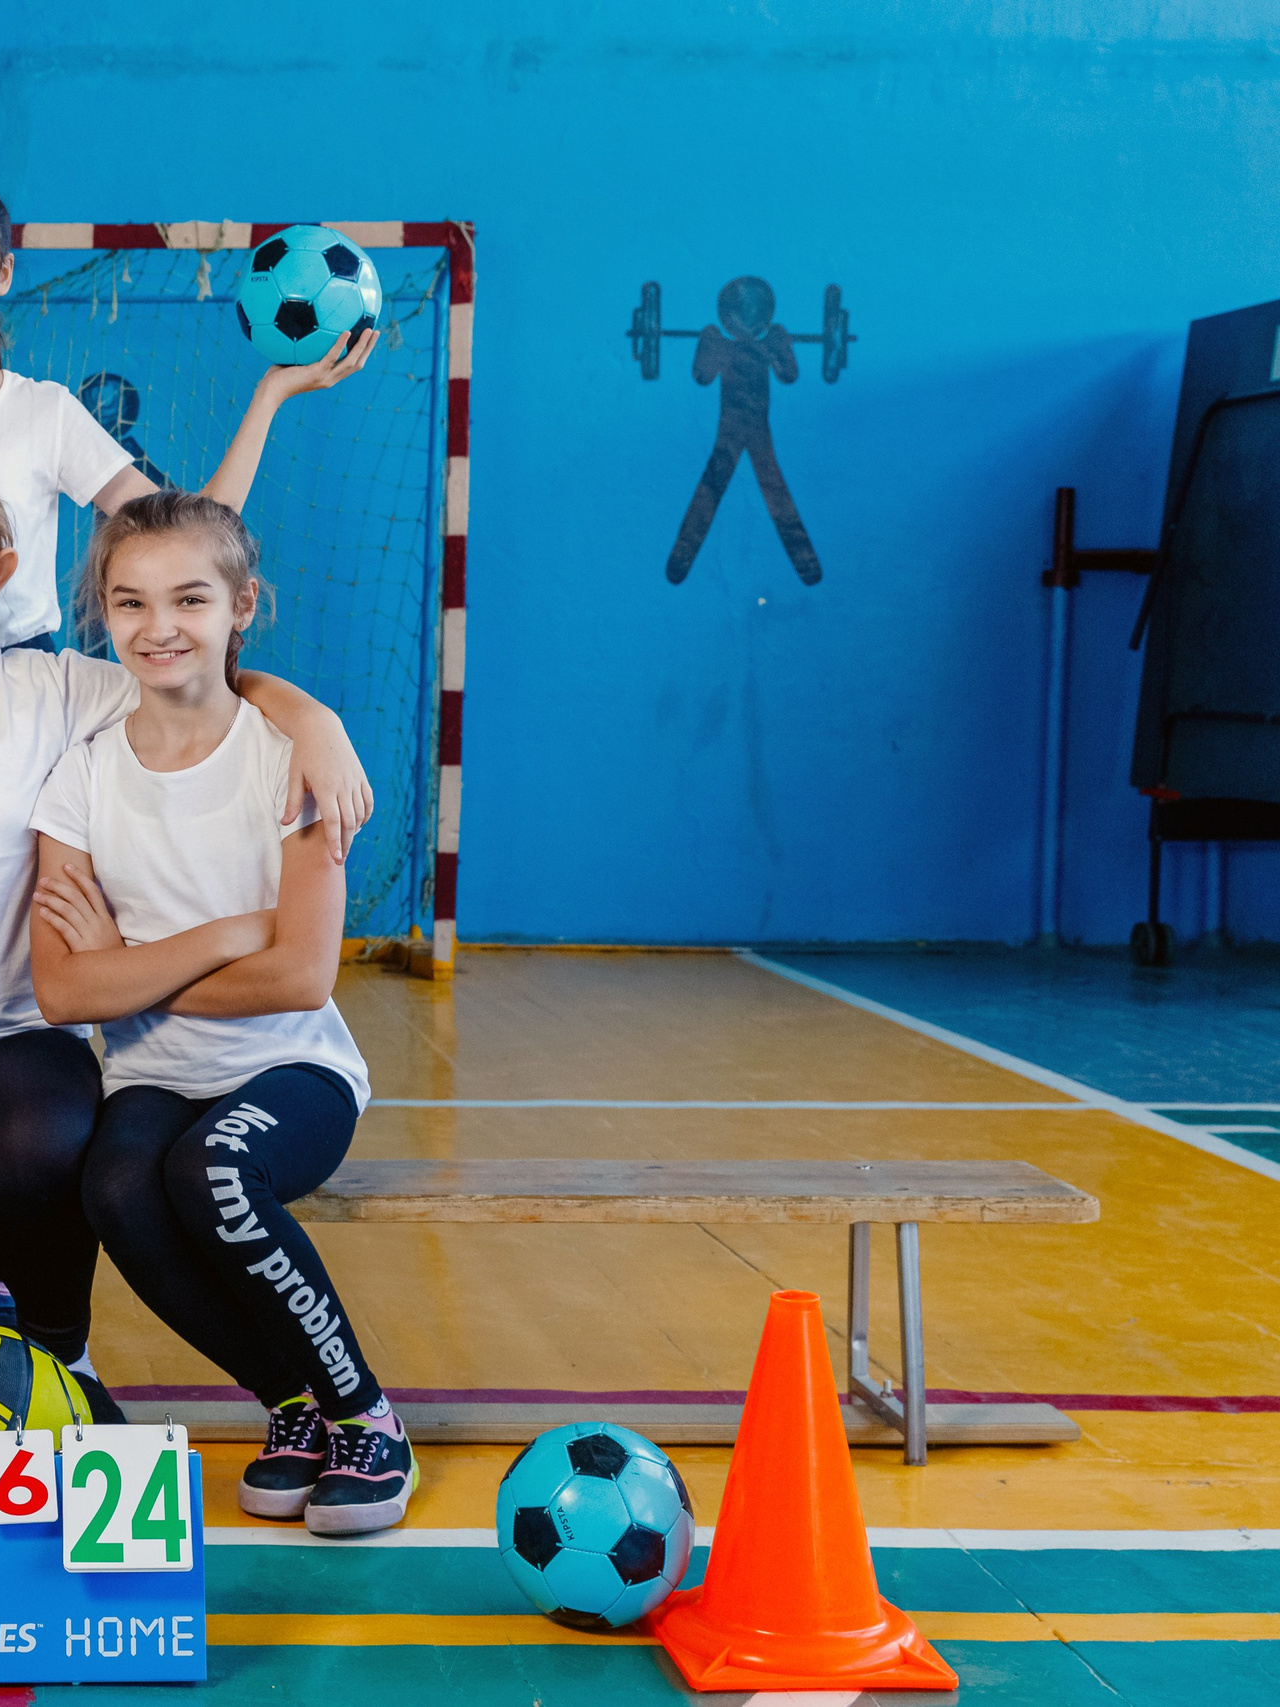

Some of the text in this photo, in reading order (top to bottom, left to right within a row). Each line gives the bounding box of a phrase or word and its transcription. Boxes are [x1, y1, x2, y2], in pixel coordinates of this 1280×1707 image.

[205, 1102, 361, 1398] Not my problem
[70, 1449, 187, 1563] 24
[556, 1505, 576, 1542] KIPSTA
[65, 1615, 195, 1658] HOME
